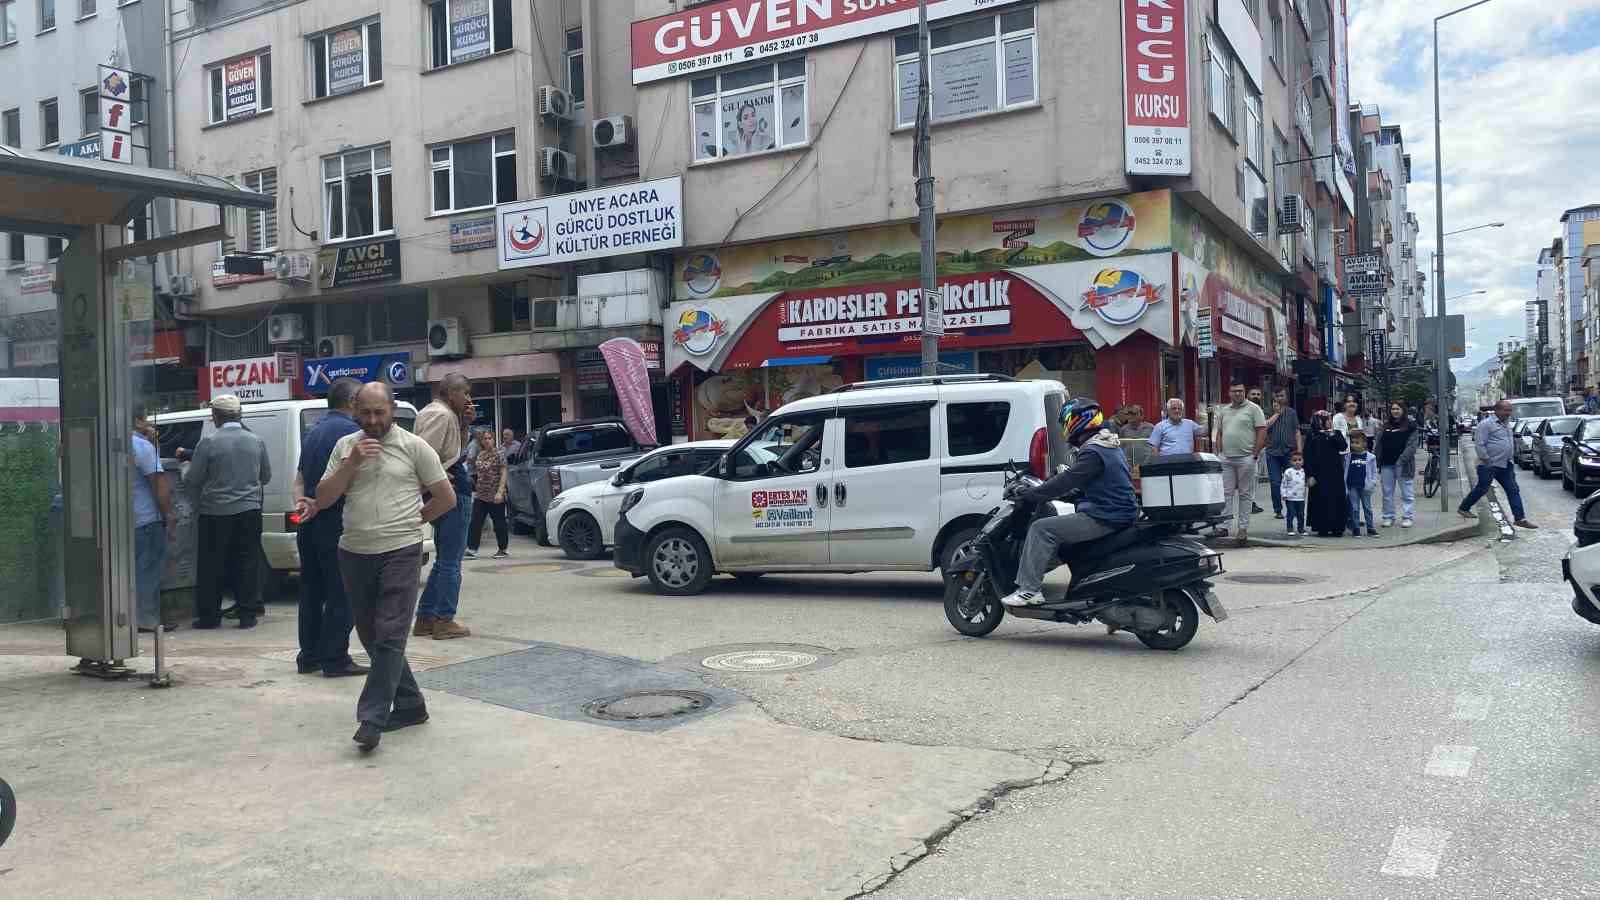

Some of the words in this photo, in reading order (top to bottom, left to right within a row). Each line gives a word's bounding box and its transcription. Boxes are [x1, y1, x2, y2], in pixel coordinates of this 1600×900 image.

[654, 0, 832, 55] GÜVEN
[678, 58, 696, 71] 0506
[696, 56, 711, 67] 397
[712, 54, 722, 64] 08
[724, 52, 733, 62] 11
[759, 42, 778, 53] 0452
[780, 39, 795, 50] 324
[797, 35, 806, 46] 07
[808, 33, 819, 44] 38
[228, 66, 255, 83] GÜVEN
[228, 80, 255, 97] SÜRÜCÜ
[1134, 93, 1180, 119] KURSU
[1134, 157, 1150, 165] 0452
[1165, 158, 1173, 166] 07
[569, 197, 606, 215] ÜNYE
[609, 189, 660, 205] ACARA
[556, 214, 604, 236] GÜRCÜ
[607, 206, 675, 229] DOSTLUK
[556, 232, 609, 255] KÜLTÜR
[613, 222, 676, 248] DERNEĞİ
[344, 243, 384, 264] AVCI
[1345, 255, 1377, 265] AVUKAT
[1350, 273, 1385, 284] AVUKAT
[789, 291, 888, 324] KARDEŞLER
[896, 278, 1011, 315] PEİRCİLİK
[800, 324, 855, 338] FABRİKA
[863, 320, 901, 334] SATIŞ
[908, 314, 983, 329] MZASI
[212, 361, 285, 388] ECZAN
[791, 489, 808, 499] YAPI
[776, 507, 814, 520] Vaillant
